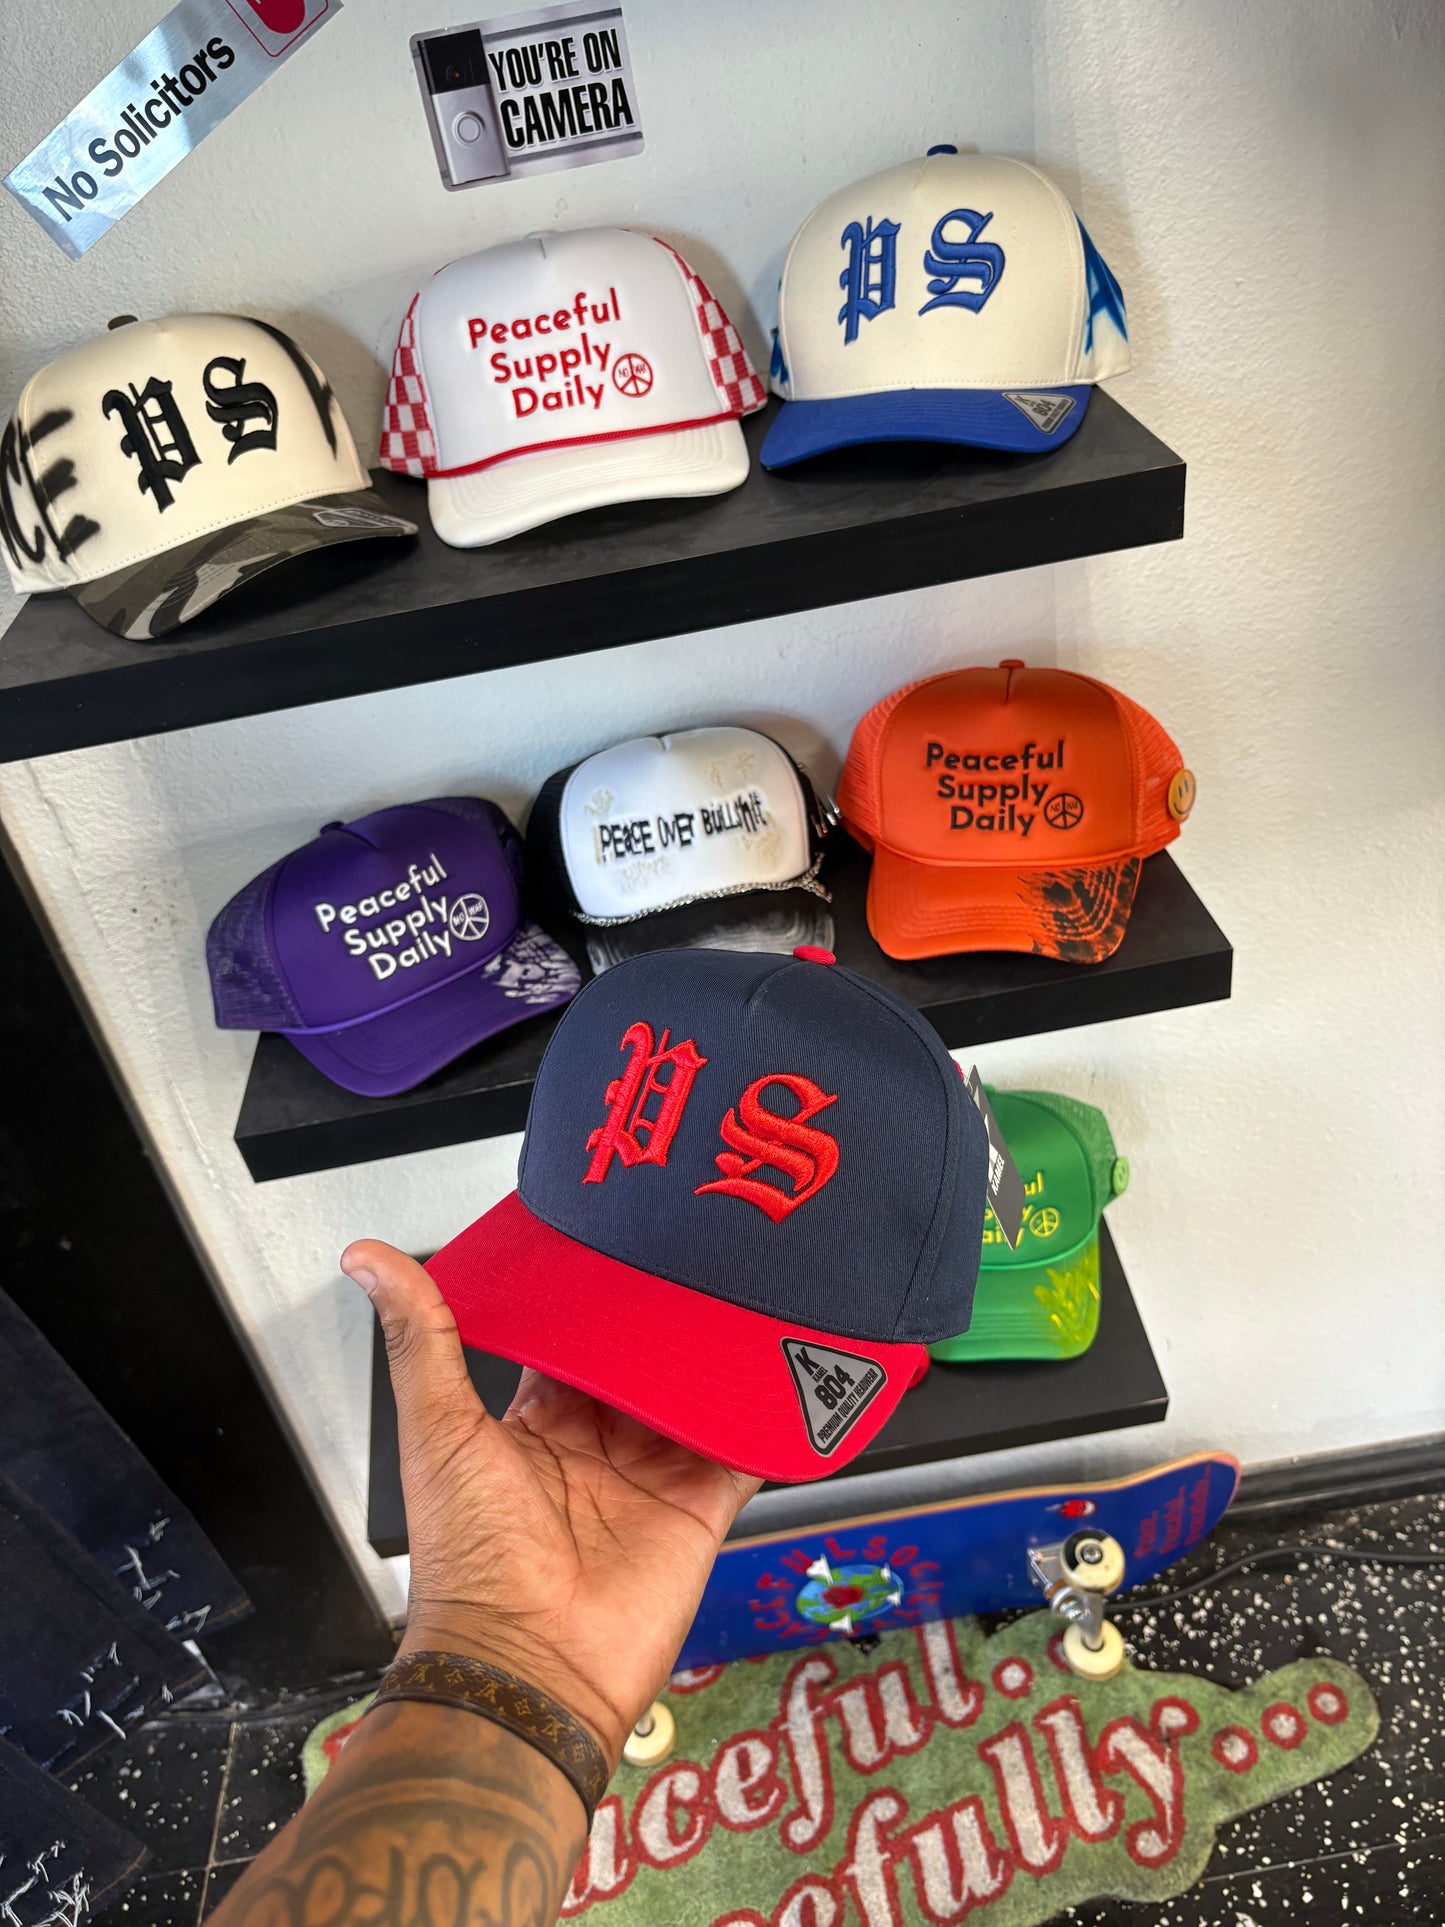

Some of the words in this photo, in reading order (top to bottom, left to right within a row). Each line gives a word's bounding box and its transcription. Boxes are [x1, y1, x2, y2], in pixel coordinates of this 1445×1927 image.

[488, 37, 580, 92] YOU'RE
[583, 28, 622, 74] ON
[42, 171, 98, 222] No
[88, 37, 235, 177] Solicitors
[500, 77, 634, 148] CAMERA
[467, 287, 621, 349] Peaceful
[490, 332, 612, 384] Supply
[512, 375, 604, 418] Daily
[926, 740, 1065, 772] Peaceful
[937, 774, 1050, 806] Supply
[950, 805, 1036, 836] Daily
[314, 853, 448, 933] Peaceful
[343, 895, 450, 956] Supply
[368, 929, 452, 981] Daily
[794, 1346, 820, 1376] K
[814, 1364, 856, 1410] 804
[817, 1411, 844, 1444] PREMIUM
[838, 1391, 860, 1418] QUALITY
[853, 1368, 880, 1398] HEADWEAR
